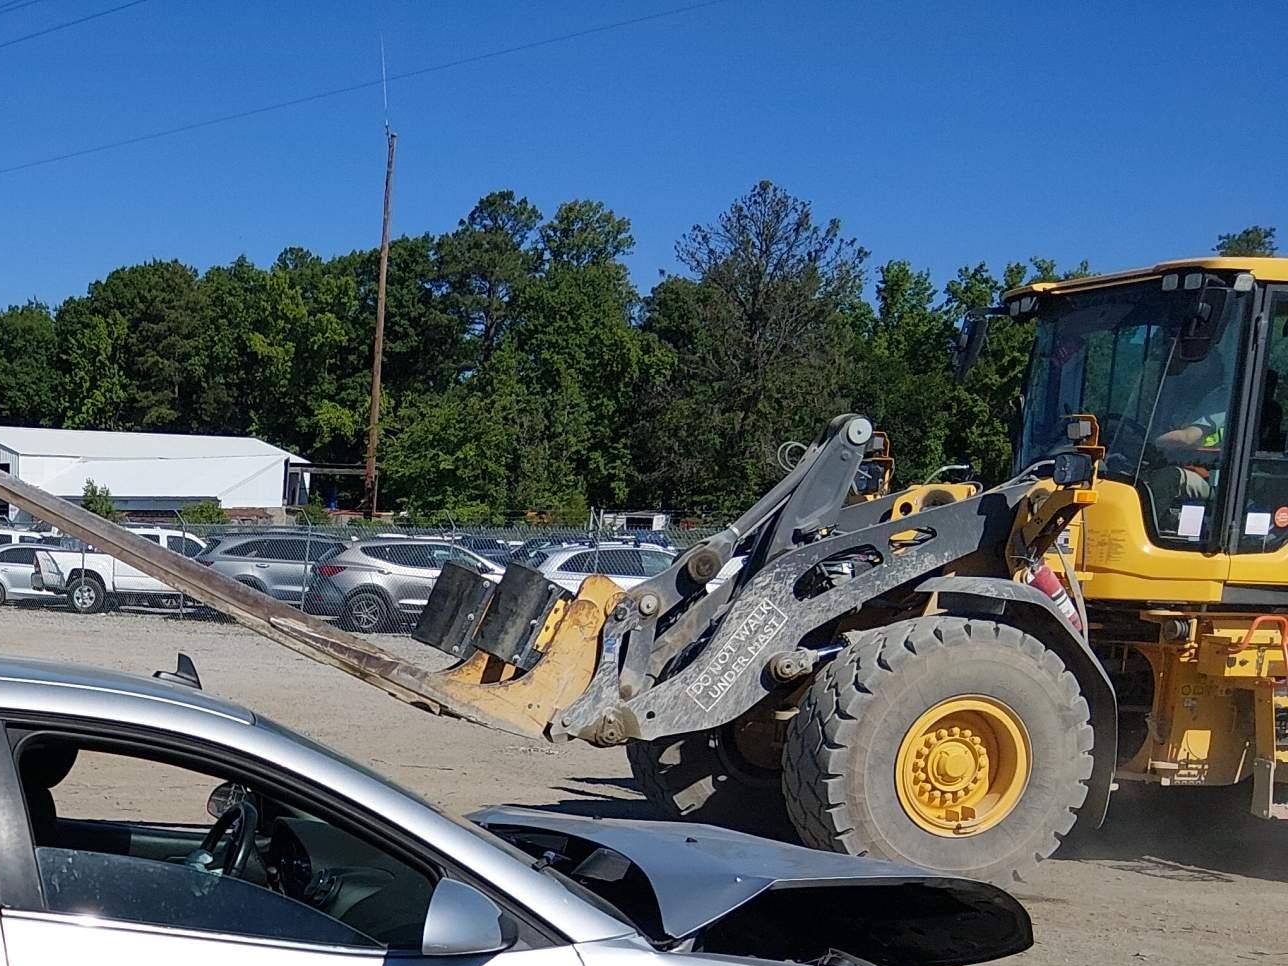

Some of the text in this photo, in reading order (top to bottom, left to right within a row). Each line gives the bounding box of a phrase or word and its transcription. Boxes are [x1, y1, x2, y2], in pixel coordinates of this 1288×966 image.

[691, 600, 773, 695] DO NOT WALK
[708, 616, 780, 698] UNDER MAST
